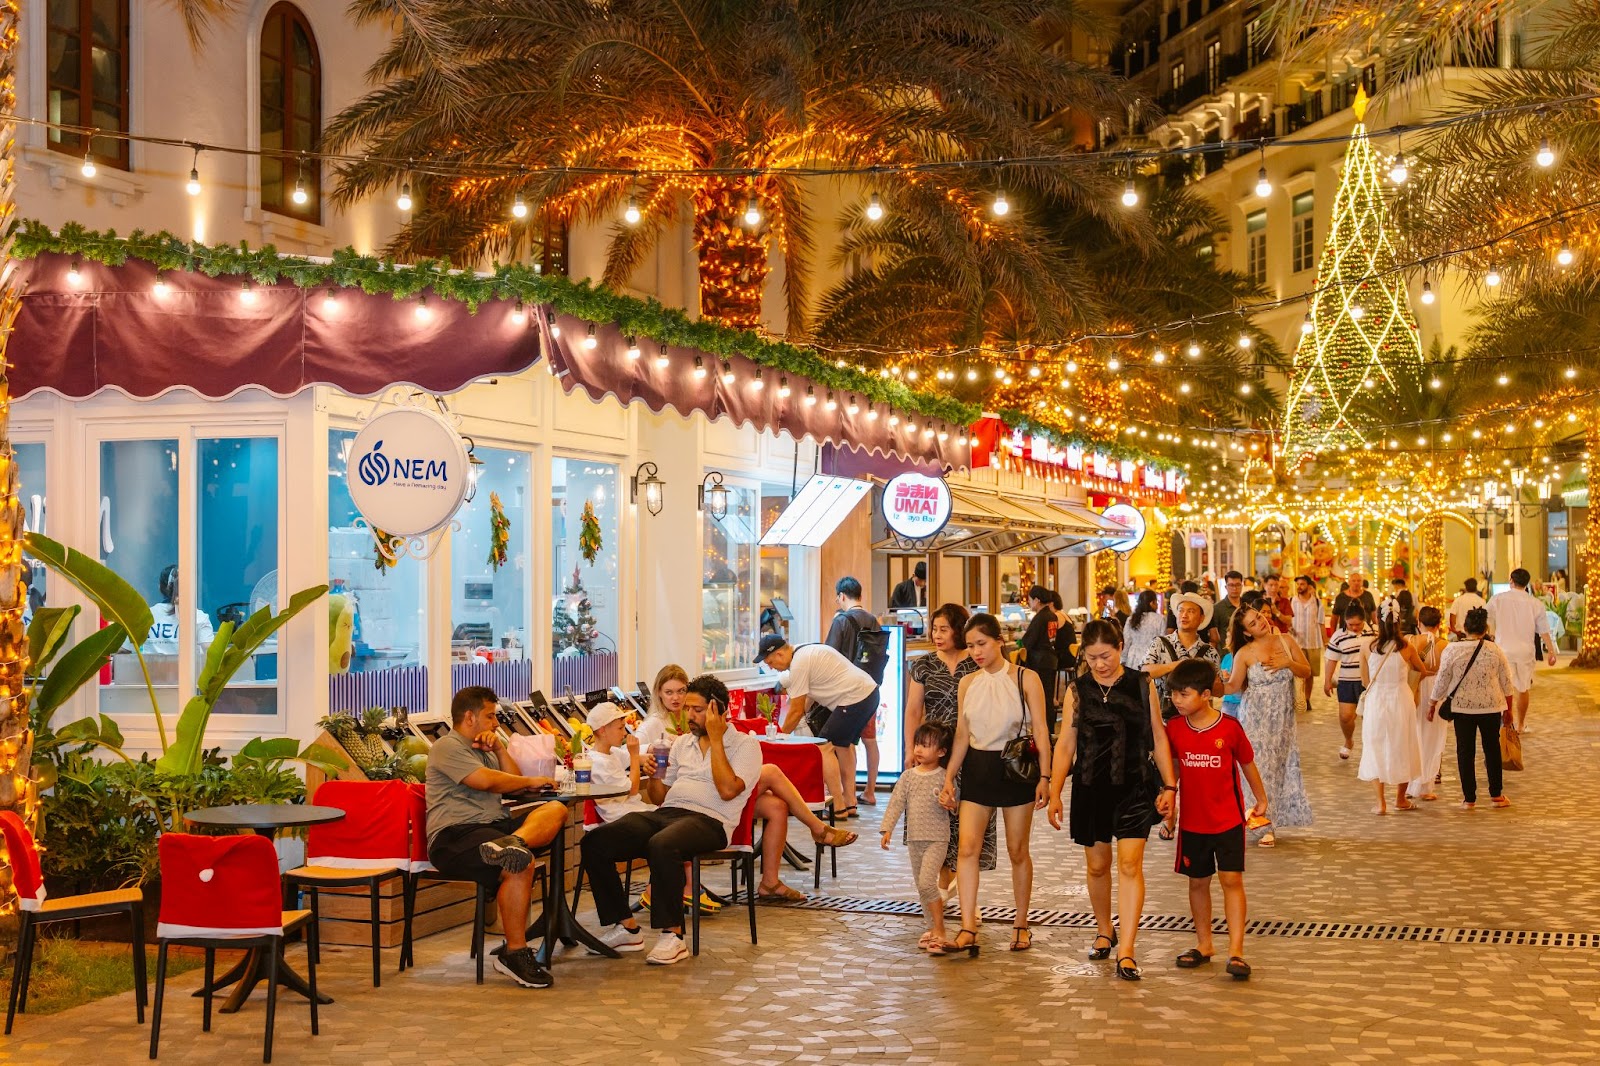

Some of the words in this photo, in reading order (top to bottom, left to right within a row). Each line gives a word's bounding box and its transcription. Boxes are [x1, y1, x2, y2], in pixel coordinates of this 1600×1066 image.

[393, 458, 448, 482] NEM
[895, 483, 939, 500] うまい
[894, 498, 938, 515] UMAI
[1185, 751, 1210, 760] Team
